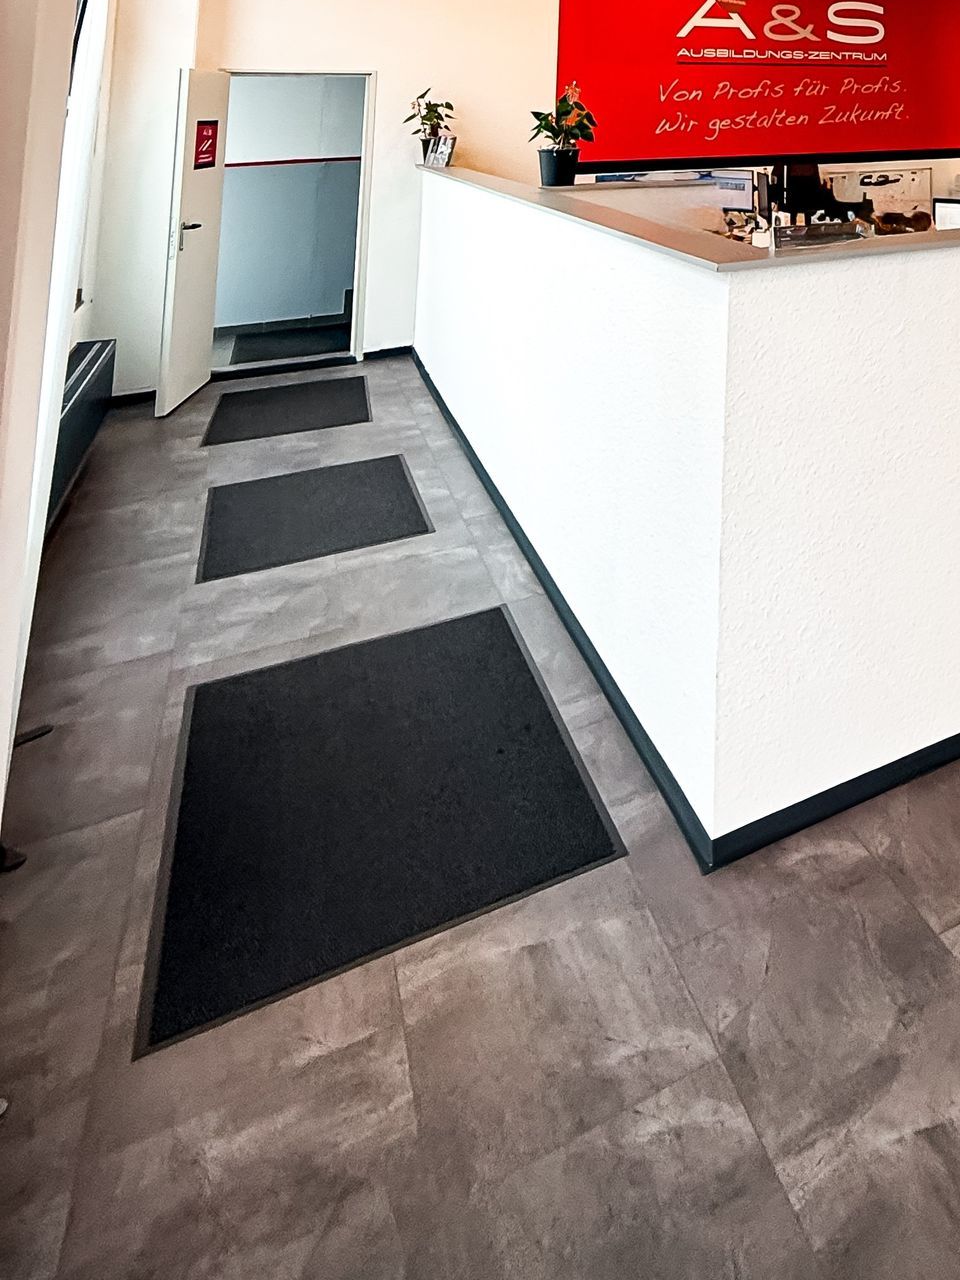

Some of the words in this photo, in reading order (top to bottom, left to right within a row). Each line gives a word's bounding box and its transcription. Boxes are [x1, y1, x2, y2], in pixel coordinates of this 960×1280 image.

[676, 48, 888, 61] AUSBILDUNGS-ZENTRUM
[658, 78, 704, 102] Von
[713, 79, 785, 101] Profis
[793, 78, 830, 97] für
[839, 75, 908, 95] Profis.
[655, 111, 699, 135] Wir
[704, 108, 809, 141] gestalten
[817, 102, 910, 126] Zukunft.
